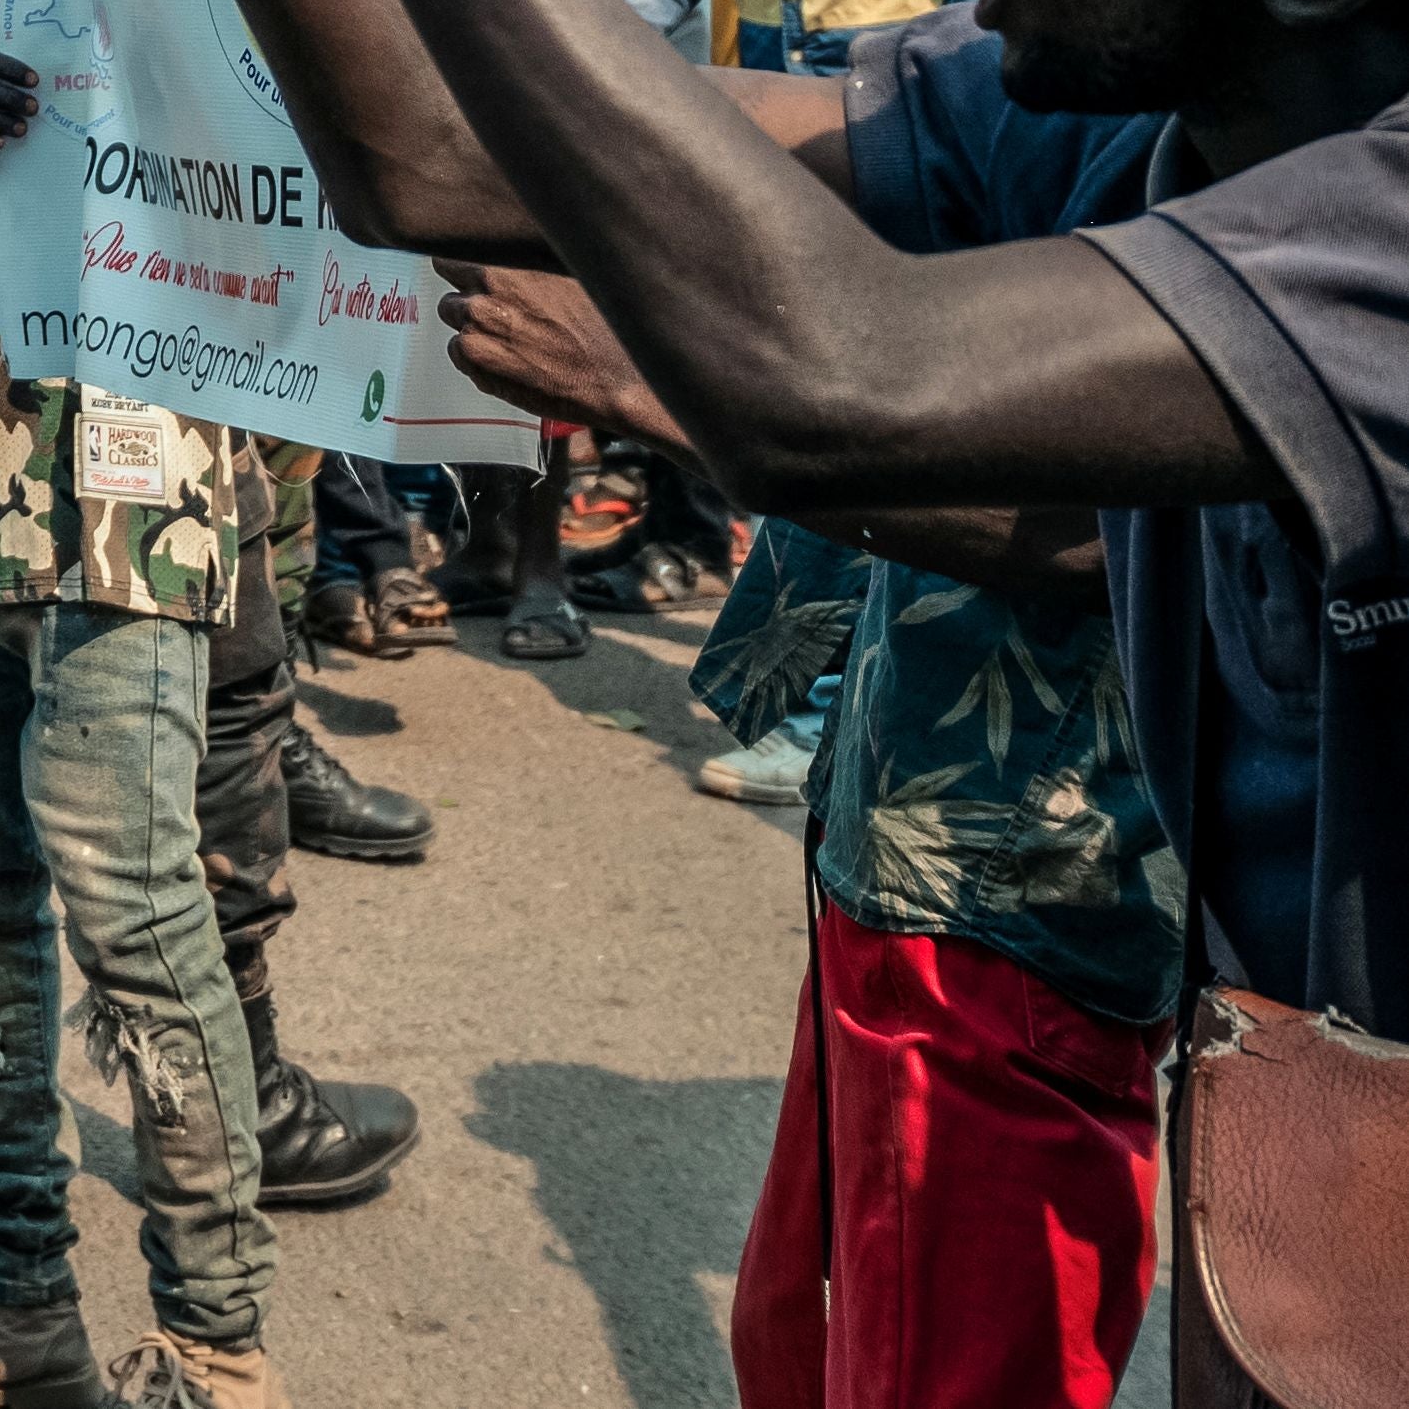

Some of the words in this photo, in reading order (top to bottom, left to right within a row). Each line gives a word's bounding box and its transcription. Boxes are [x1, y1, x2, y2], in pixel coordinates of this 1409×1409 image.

[239, 47, 271, 93] Pour
[44, 104, 74, 129] Pour
[251, 164, 304, 228] DE
